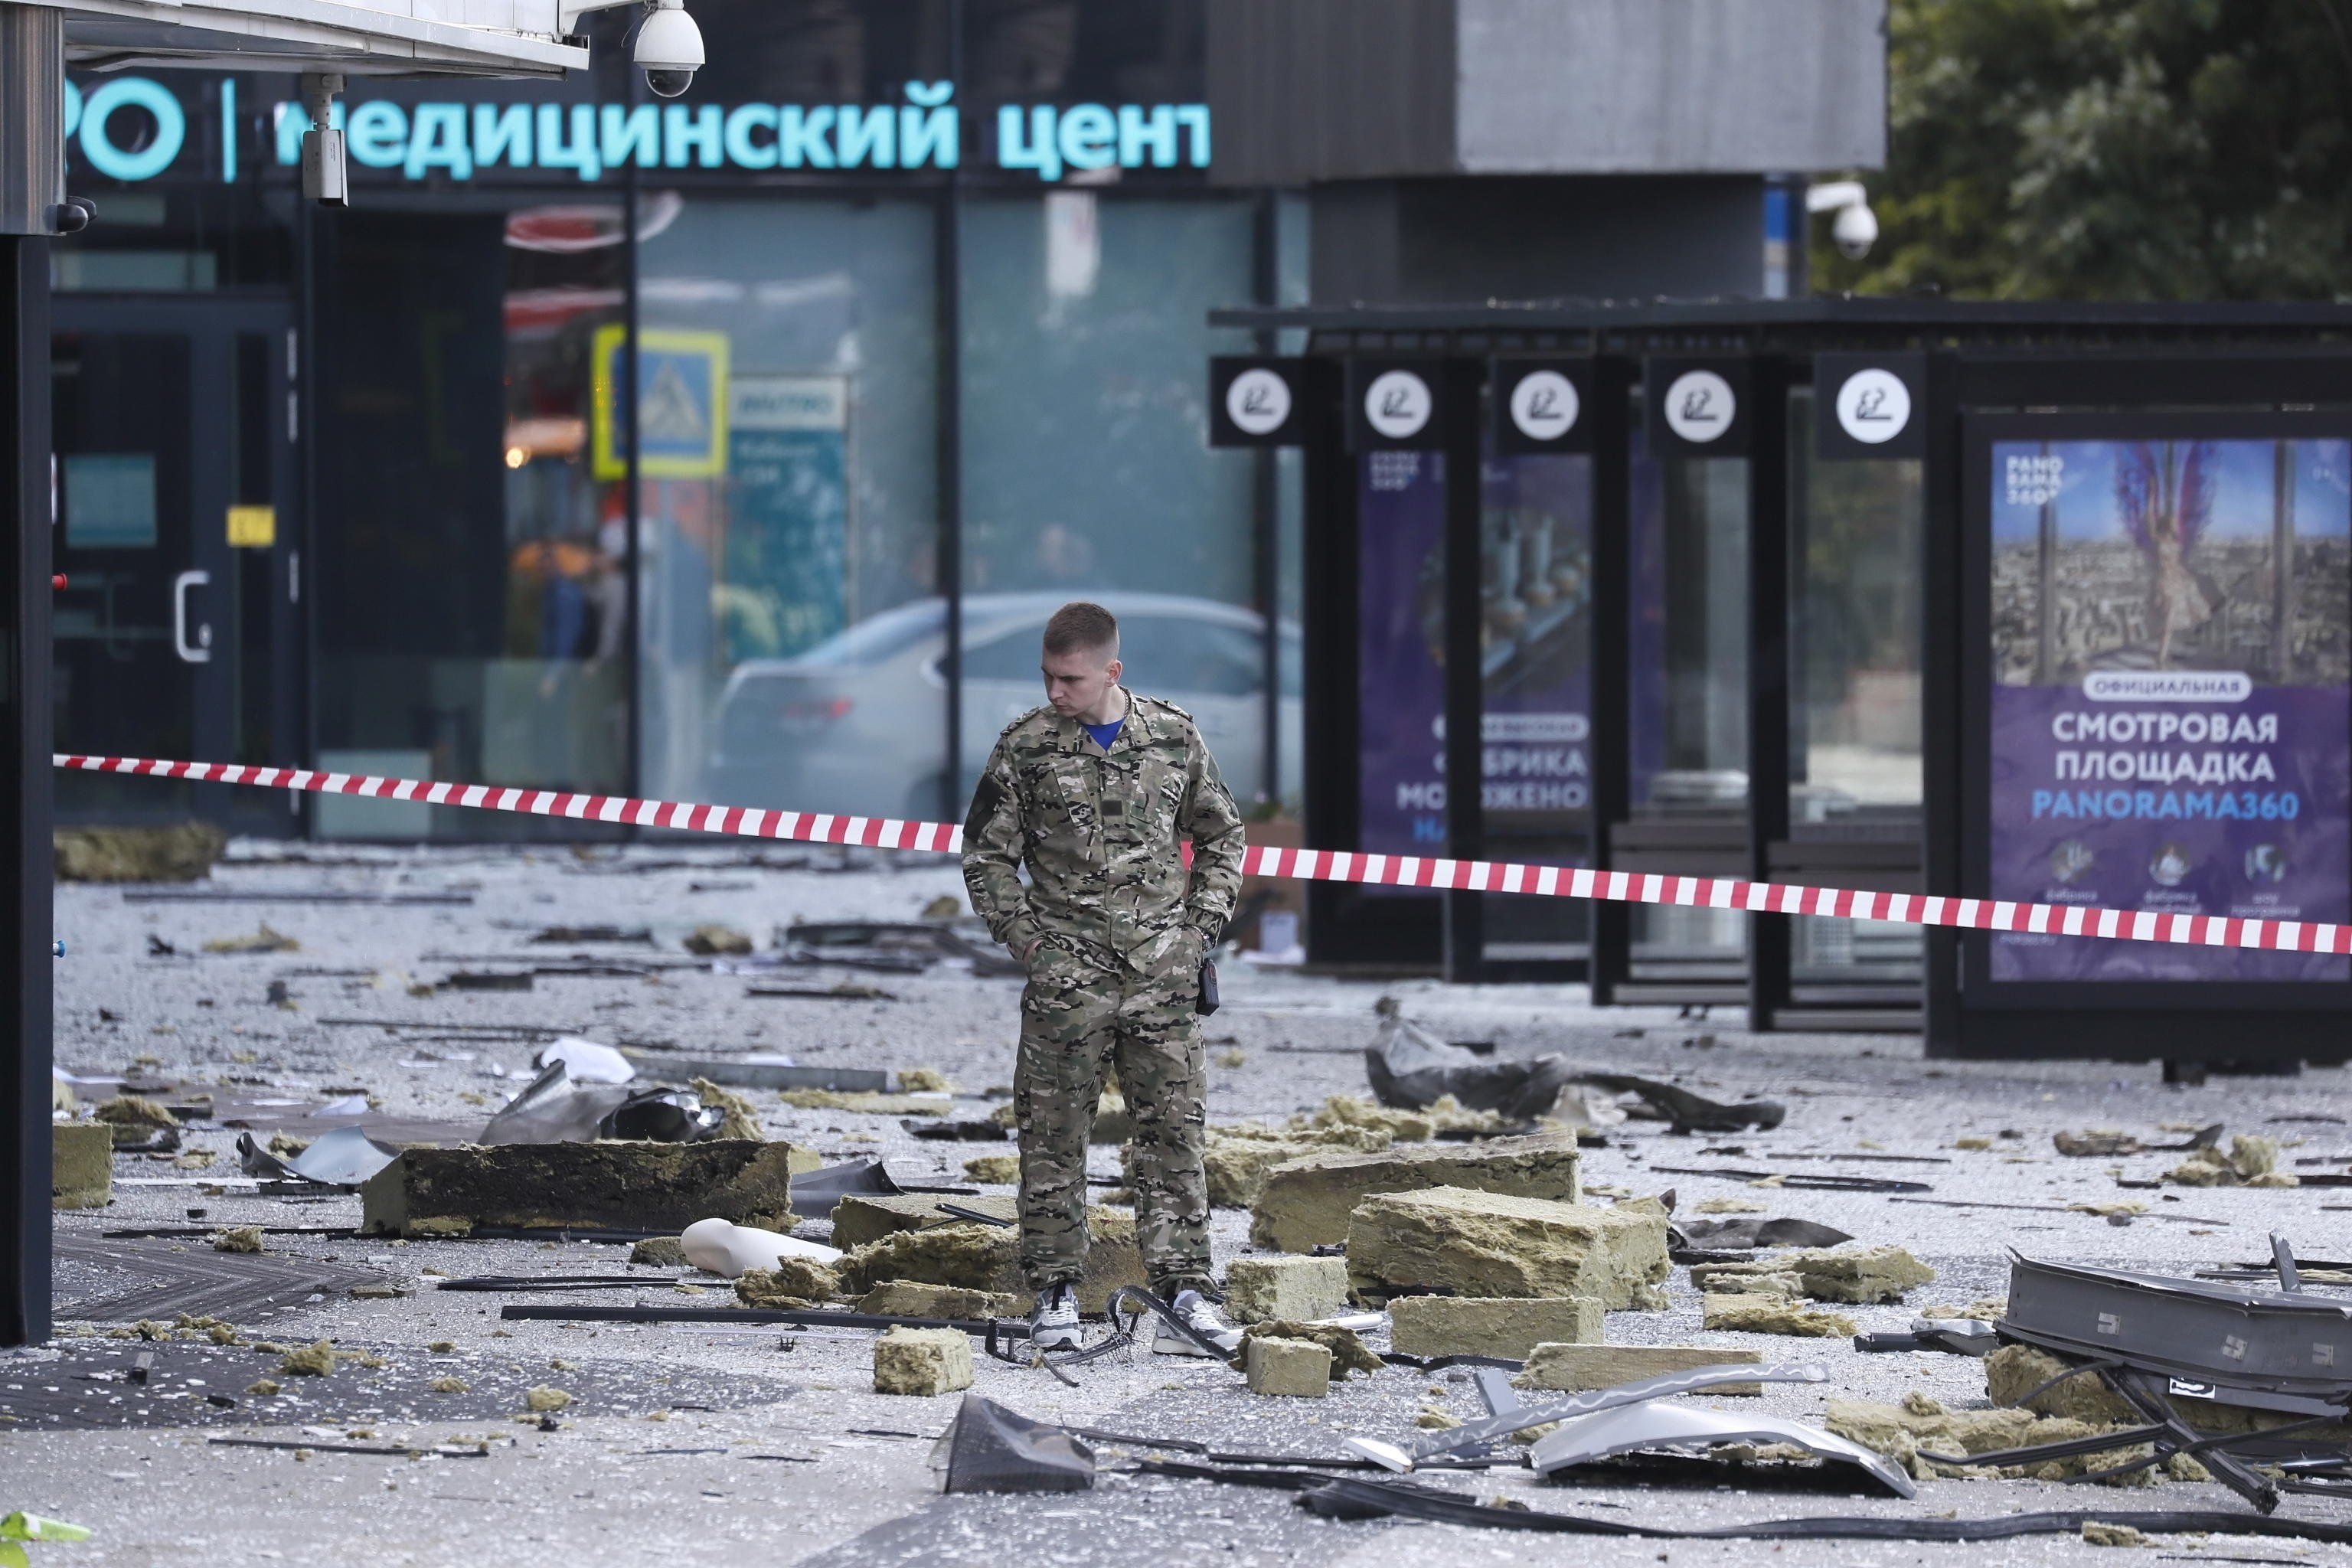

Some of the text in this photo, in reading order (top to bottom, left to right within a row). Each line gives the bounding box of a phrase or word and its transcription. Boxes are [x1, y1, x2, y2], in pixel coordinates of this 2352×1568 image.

[276, 80, 958, 181] медицинский
[2094, 680, 2241, 696] ОФИЦИАЛЬНАЯ
[2052, 712, 2279, 743] СМОТРОВАЯ
[2055, 750, 2277, 785] ПЛОЩАДКА
[2031, 789, 2299, 821] PANORAMA360
